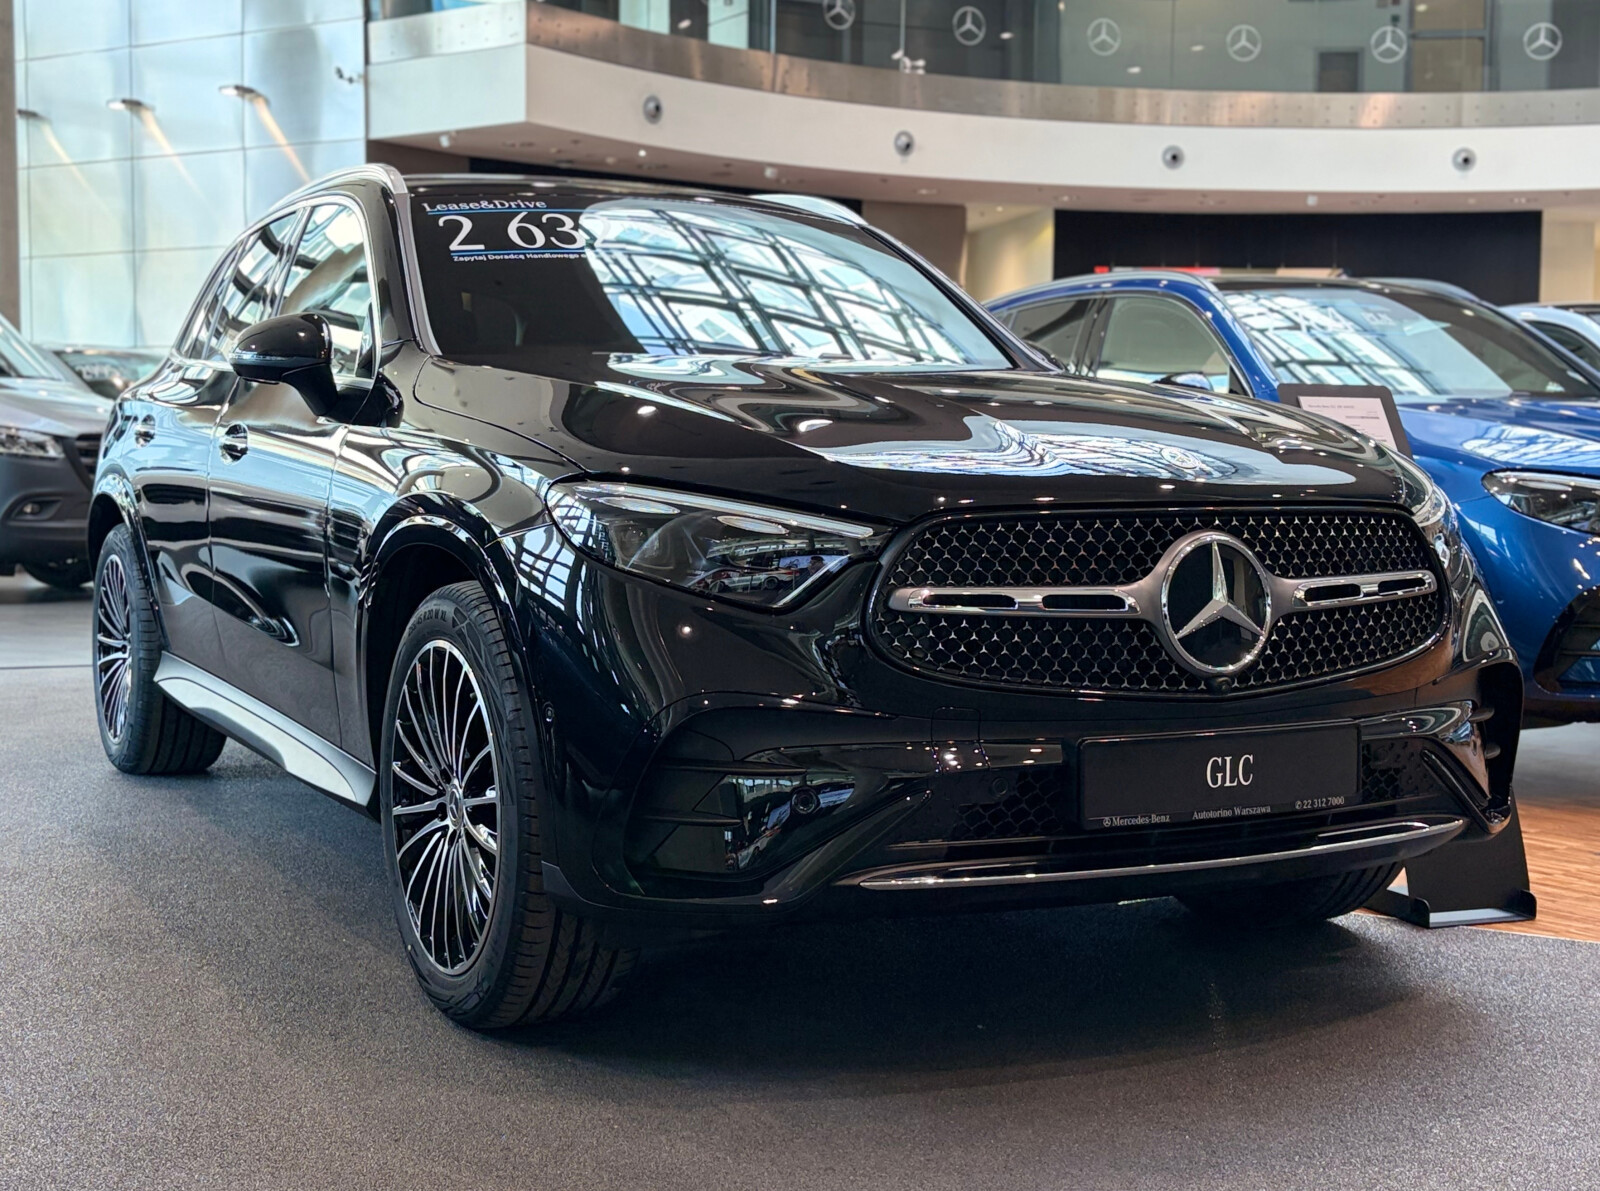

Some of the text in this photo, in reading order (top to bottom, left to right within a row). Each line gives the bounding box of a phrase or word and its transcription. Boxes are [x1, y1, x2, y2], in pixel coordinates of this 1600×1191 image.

[421, 199, 548, 212] Lease&Drive
[437, 214, 486, 251] 2
[452, 254, 487, 262] Zapytaj
[526, 252, 580, 260] Handlowego
[1206, 754, 1254, 788] GLC
[1112, 796, 1345, 827] Mercedes-Benz Autotorino Warszawa 22 312 7000
